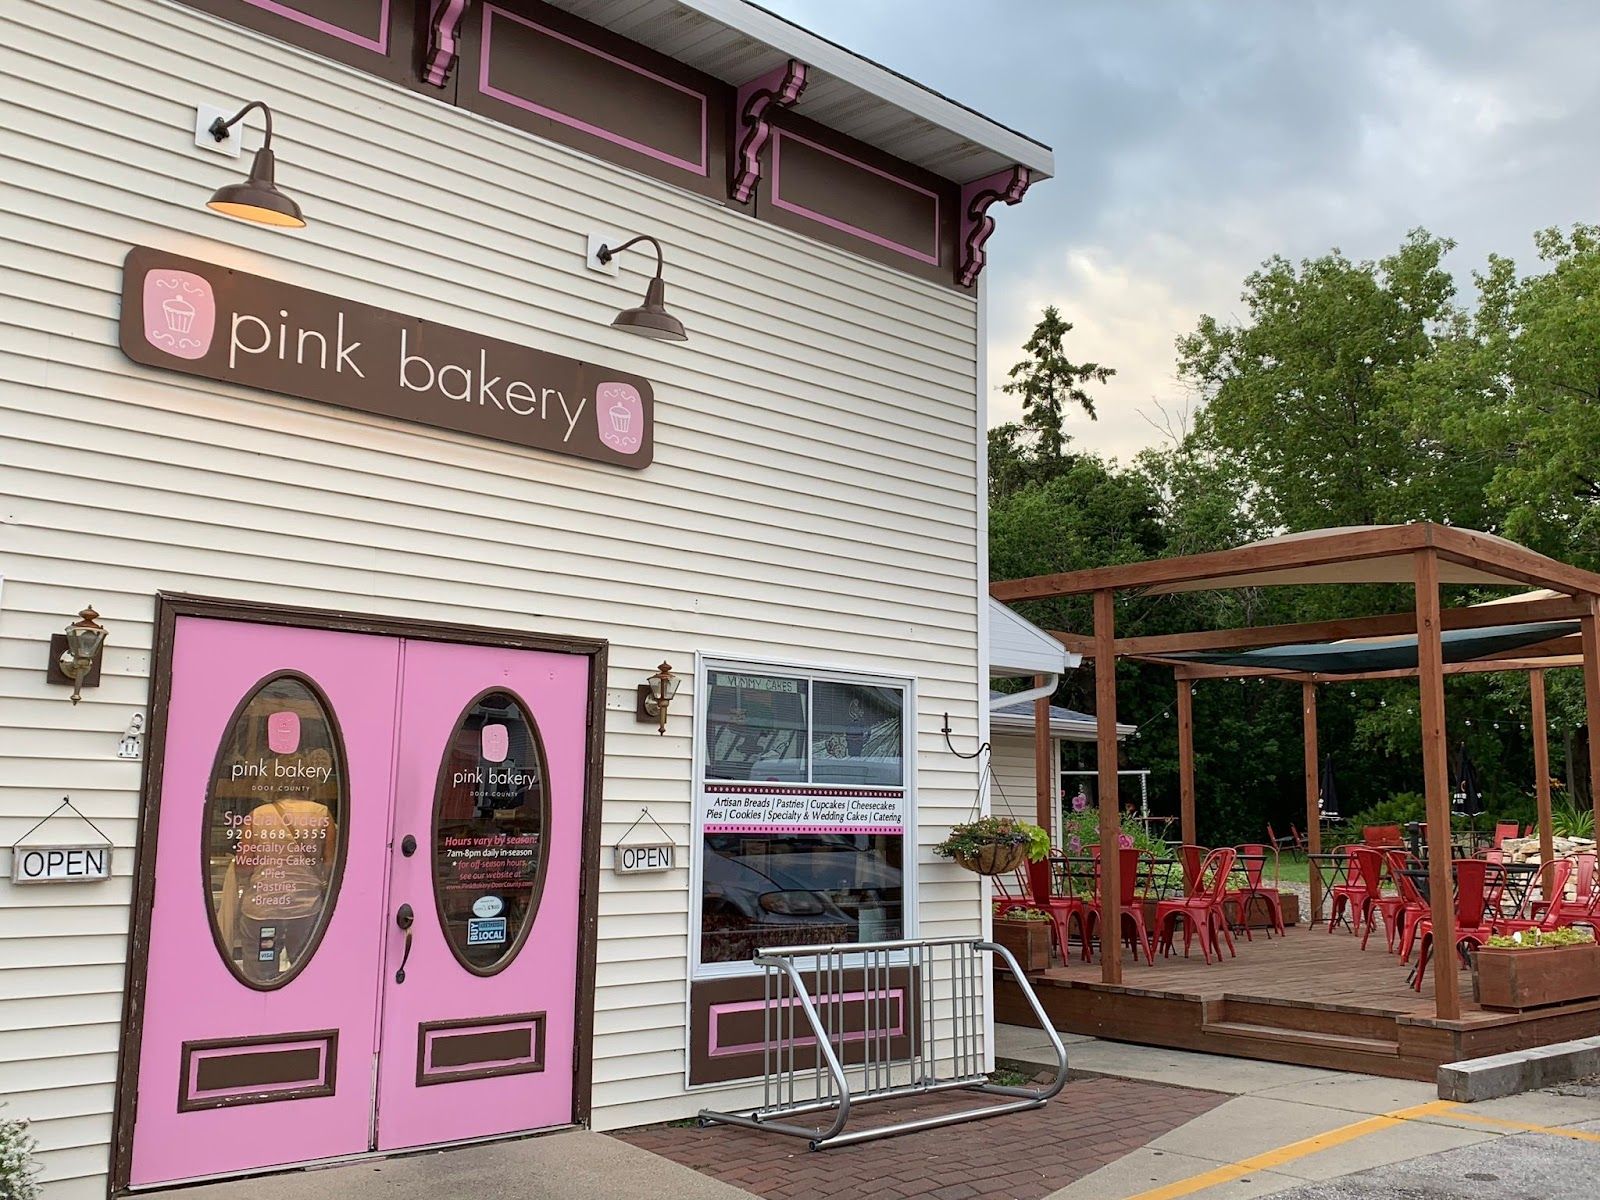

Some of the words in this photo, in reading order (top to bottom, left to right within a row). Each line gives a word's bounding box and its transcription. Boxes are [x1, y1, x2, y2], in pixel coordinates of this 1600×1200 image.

[229, 310, 365, 378] pink
[400, 328, 587, 442] bakery
[232, 758, 268, 782] pink
[274, 758, 333, 783] bakery
[453, 766, 483, 789] pink
[488, 767, 536, 790] bakery
[713, 797, 742, 807] Artisan
[744, 797, 770, 808] Breads
[776, 798, 805, 809] Pastries
[810, 799, 846, 812] Cupcakes
[851, 800, 896, 810] Cheesecakes
[223, 811, 277, 829] Special
[282, 812, 330, 828] Orders
[706, 808, 723, 819] Pies
[729, 809, 762, 819] Cookies
[767, 809, 802, 823] Specialty
[803, 811, 809, 819] &
[812, 810, 845, 823] Wedding
[846, 811, 868, 821] Cakes
[873, 812, 902, 824] Catering
[226, 829, 327, 840] 920-868-3355
[236, 841, 285, 855] Specialty
[286, 841, 318, 853] Cakes
[445, 836, 472, 847] Hours
[473, 838, 493, 848] vary
[493, 835, 506, 847] by
[446, 849, 481, 859] 7am-8pm
[482, 848, 500, 859] daily
[500, 848, 533, 857] in-season
[623, 847, 669, 869] OPEN
[23, 850, 104, 878] OPEN
[235, 855, 284, 868] Wedding
[286, 855, 317, 866] Cakes
[458, 860, 470, 870] for
[470, 860, 506, 870] off-season
[264, 868, 286, 879] Pies
[459, 873, 472, 881] see
[472, 872, 486, 880] our
[486, 871, 513, 879] website
[256, 881, 297, 892] Pastries
[255, 895, 292, 906] Breads
[470, 923, 479, 941] BUY
[478, 930, 503, 940] LOCAL
